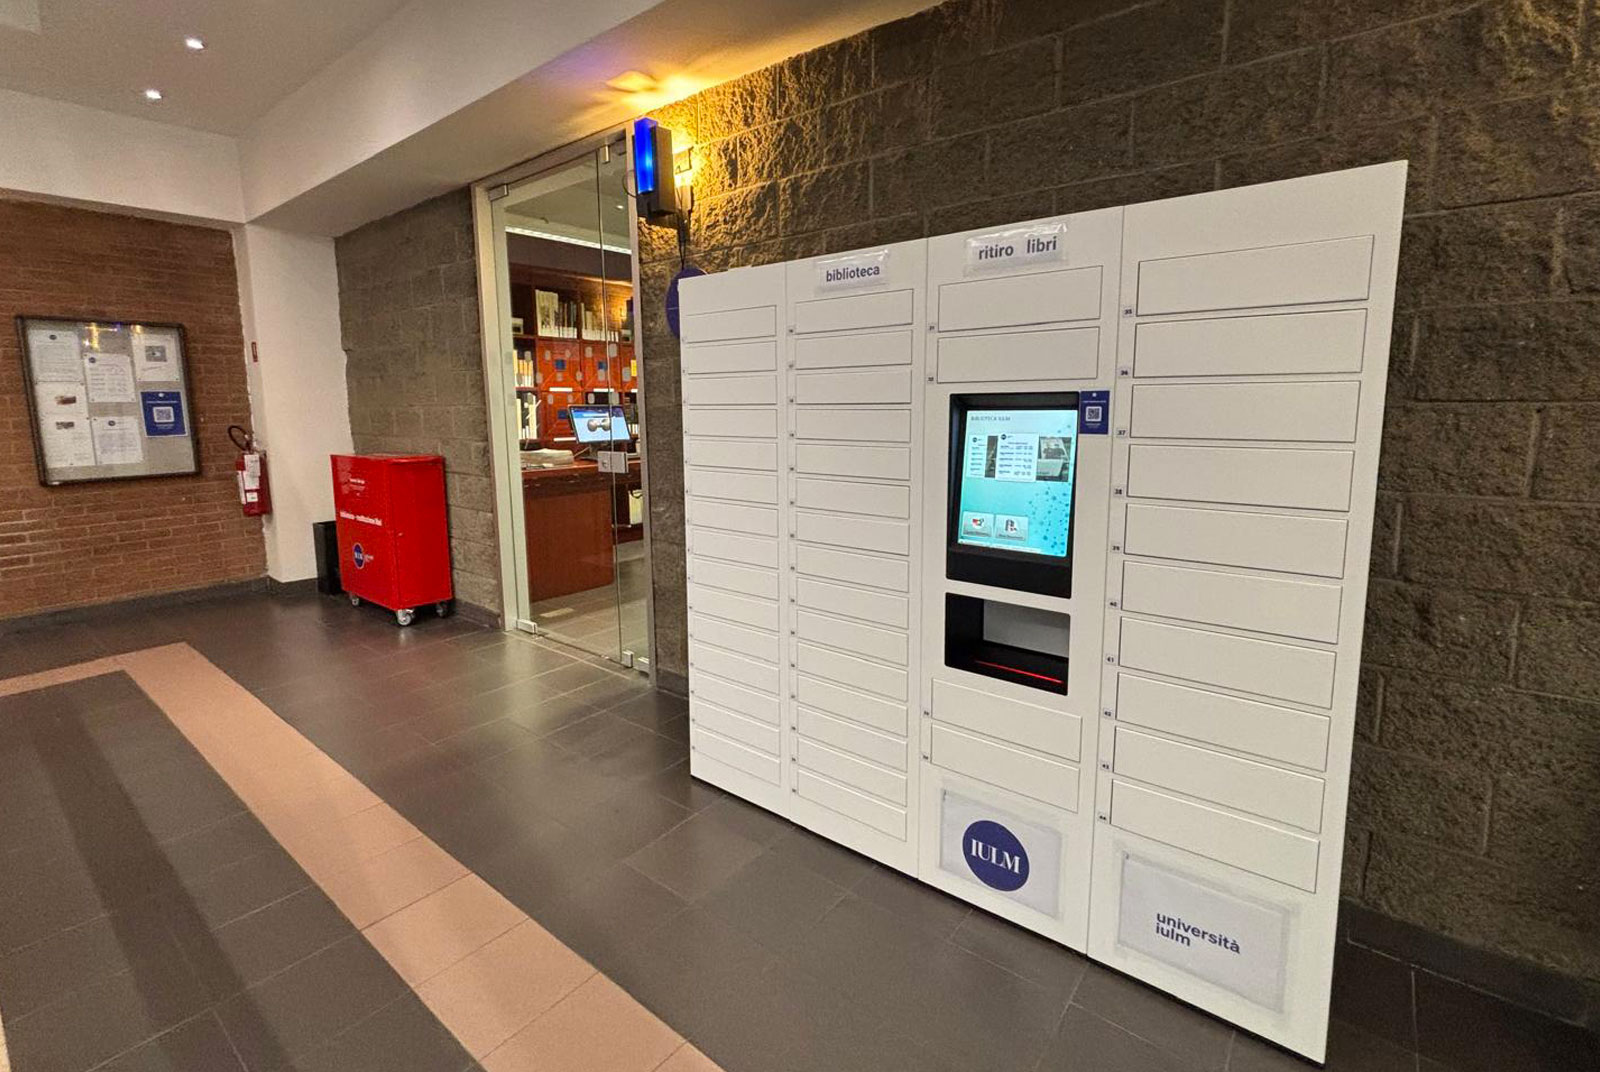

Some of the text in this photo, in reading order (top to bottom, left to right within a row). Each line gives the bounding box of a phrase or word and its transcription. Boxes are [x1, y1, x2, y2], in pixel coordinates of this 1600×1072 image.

[979, 236, 1056, 259] ritiro libri
[826, 265, 880, 283] biblioteca
[970, 838, 1021, 875] IULM
[1156, 912, 1241, 954] università
[1156, 924, 1191, 947] iulm
